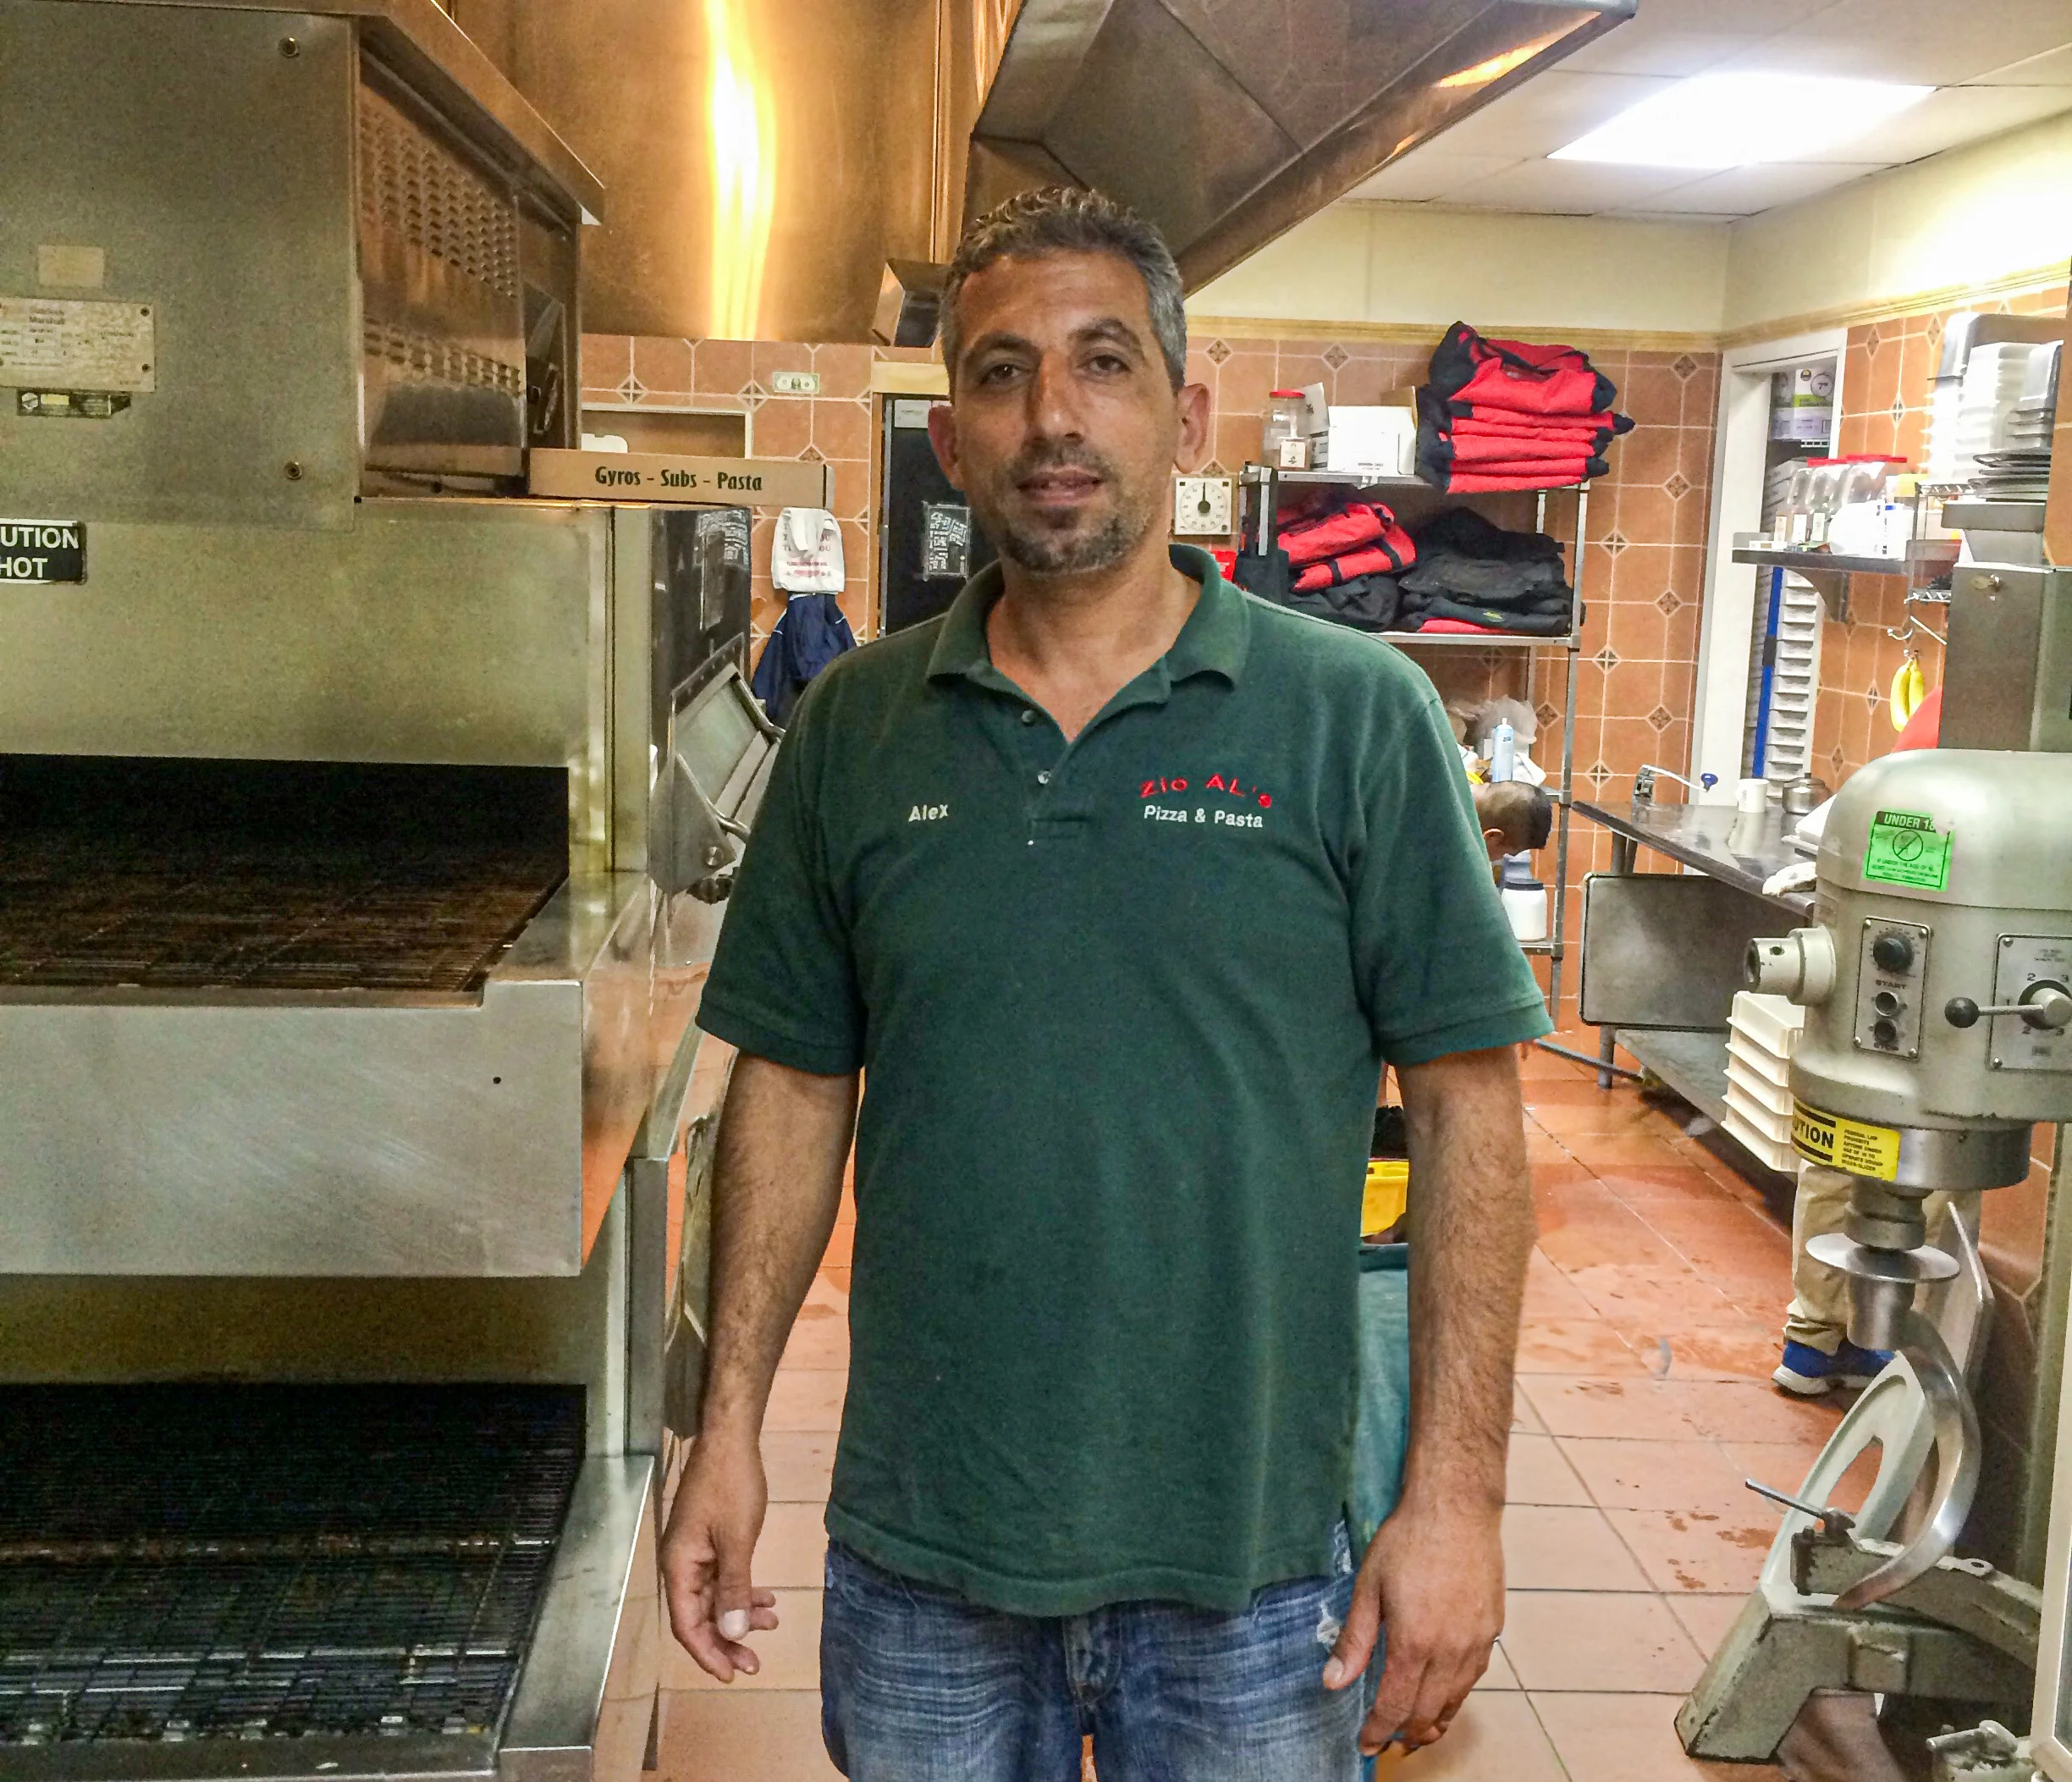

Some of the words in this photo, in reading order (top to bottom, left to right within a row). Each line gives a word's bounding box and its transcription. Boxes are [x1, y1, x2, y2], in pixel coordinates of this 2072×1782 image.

[595, 466, 641, 487] Gyros
[660, 469, 697, 488] Subs
[717, 472, 763, 491] Pasta
[0, 556, 48, 578] HOT
[1143, 804, 1188, 823] Pizza
[1194, 808, 1206, 824] &
[1214, 810, 1264, 828] Pasta
[1883, 814, 1920, 829] UNDER
[1875, 979, 1907, 989] START
[2026, 973, 2036, 981] 2
